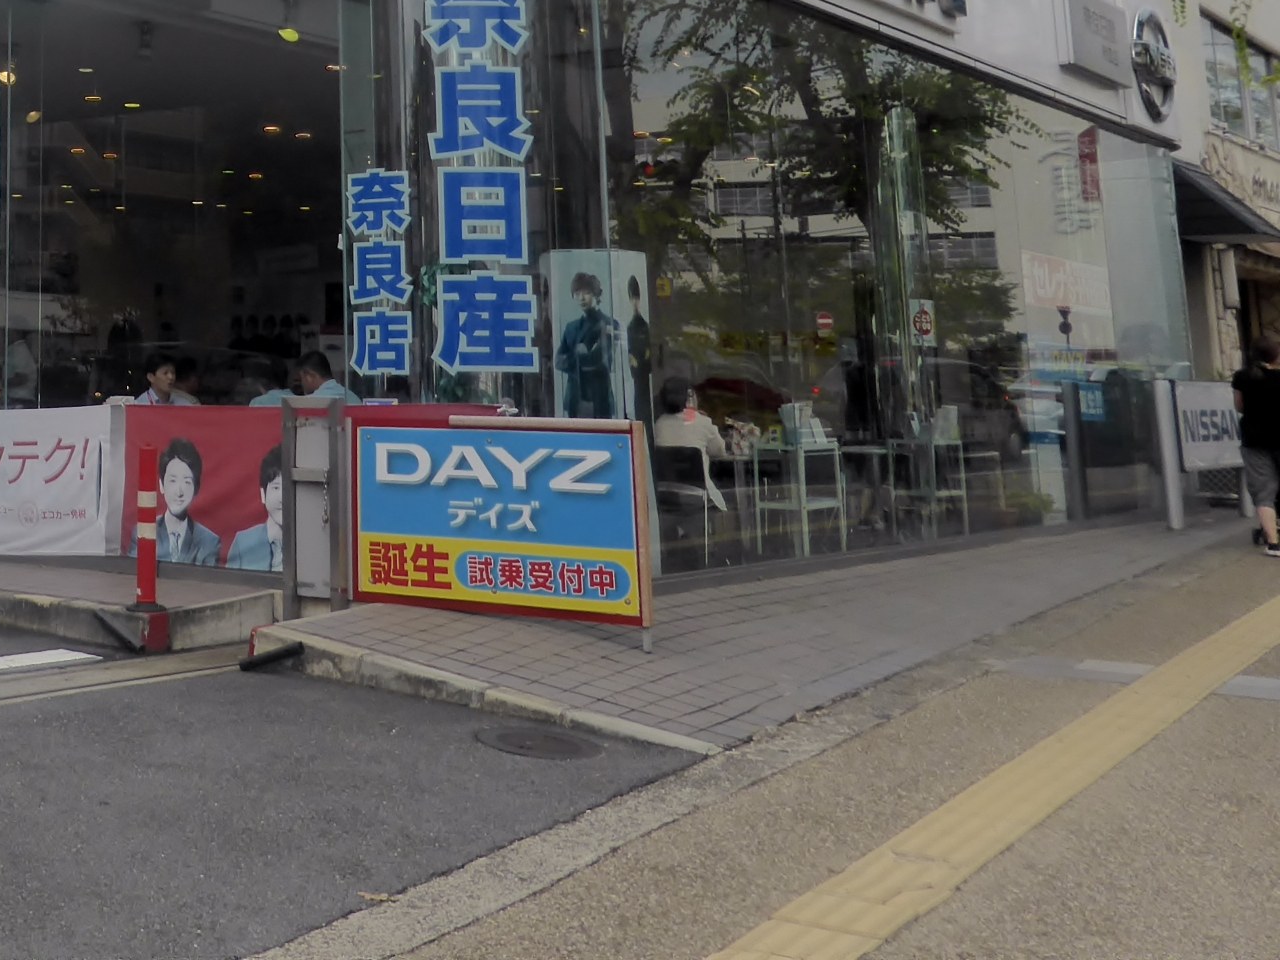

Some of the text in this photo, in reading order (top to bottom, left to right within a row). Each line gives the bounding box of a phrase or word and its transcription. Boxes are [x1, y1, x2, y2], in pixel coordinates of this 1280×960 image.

[346, 168, 414, 377] 奈良店
[374, 442, 613, 494] DAYZ
[368, 541, 452, 591] 誕生
[466, 555, 616, 597] 試乗受付中
